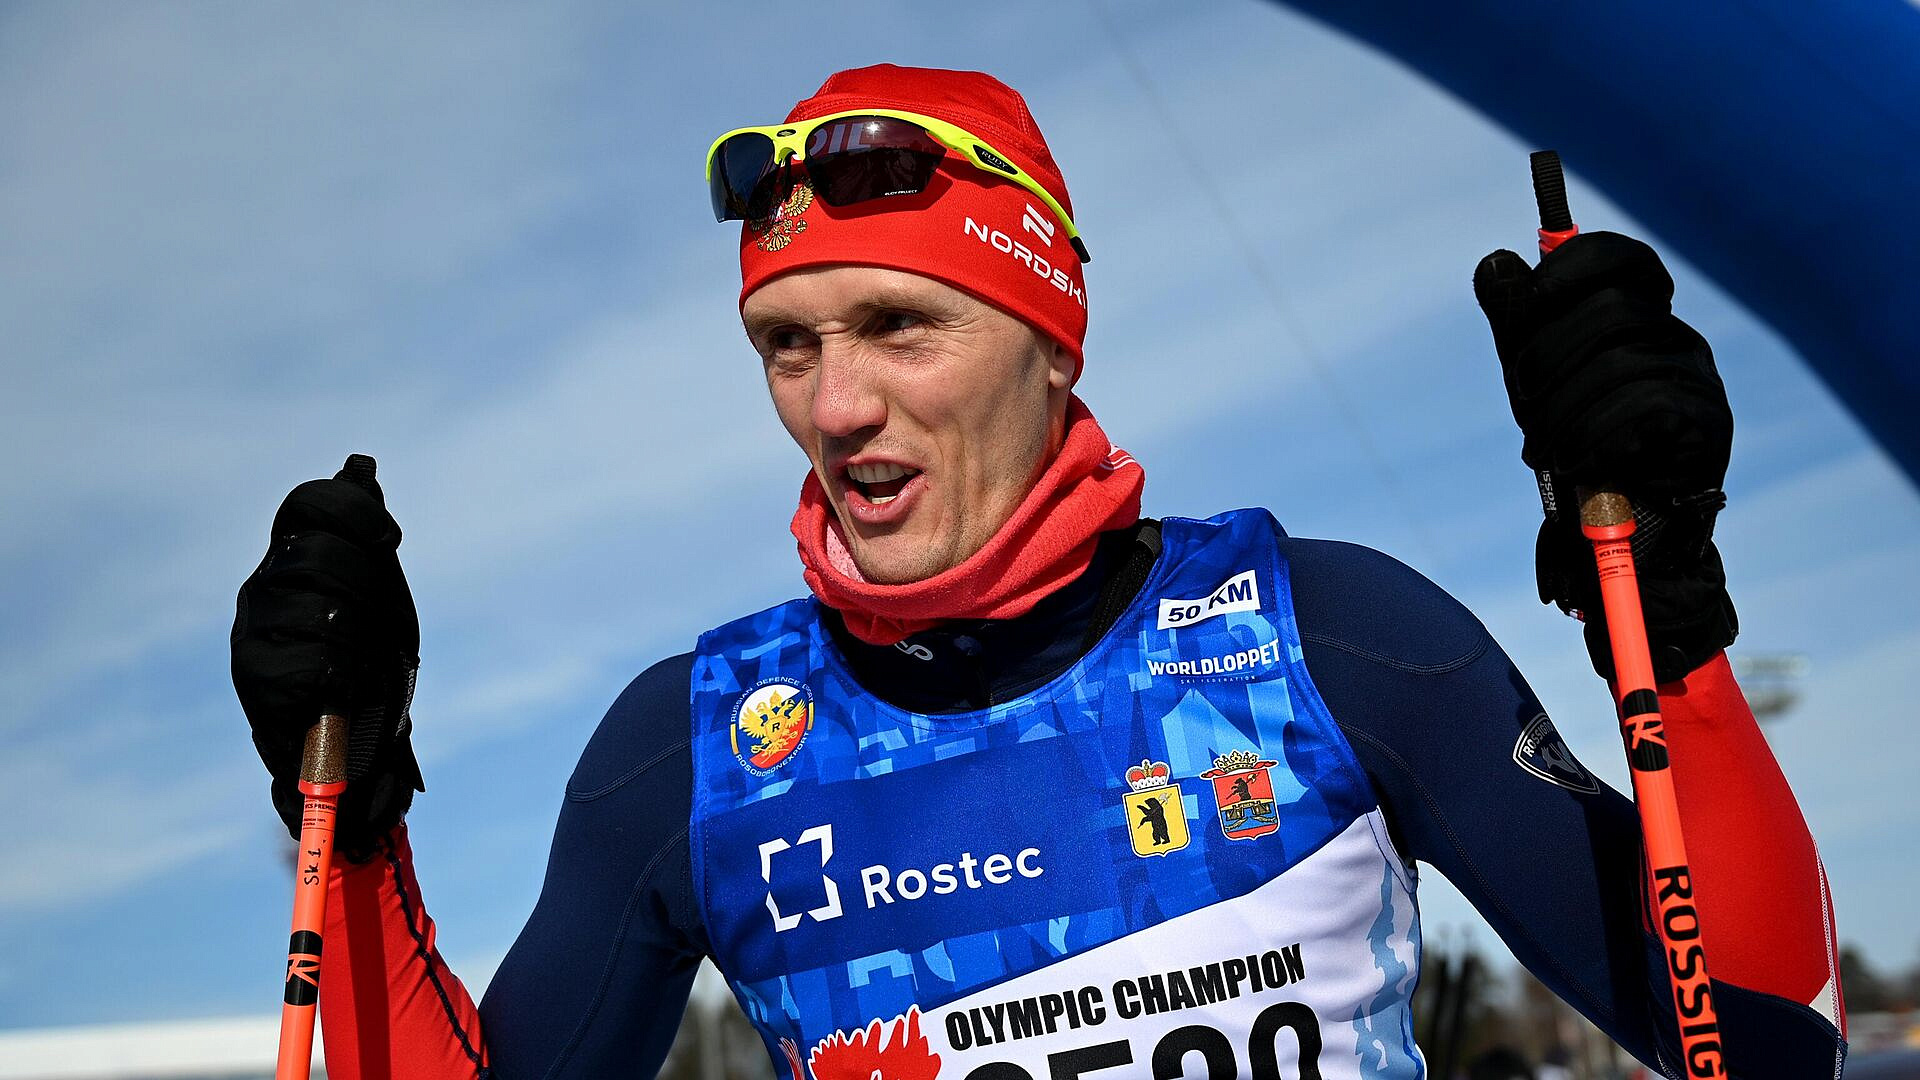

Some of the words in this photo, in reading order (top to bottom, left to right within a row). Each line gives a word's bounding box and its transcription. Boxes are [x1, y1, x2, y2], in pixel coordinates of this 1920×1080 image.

[1167, 605, 1202, 623] 50
[1208, 579, 1253, 611] KM
[1147, 639, 1280, 677] WORLDLOPPET
[730, 686, 753, 723] RUSSIAN
[757, 677, 800, 687] DEFENCE
[861, 847, 1045, 909] Rostec
[944, 985, 1107, 1052] OLYMPIC
[1112, 942, 1306, 1019] CHAMPION
